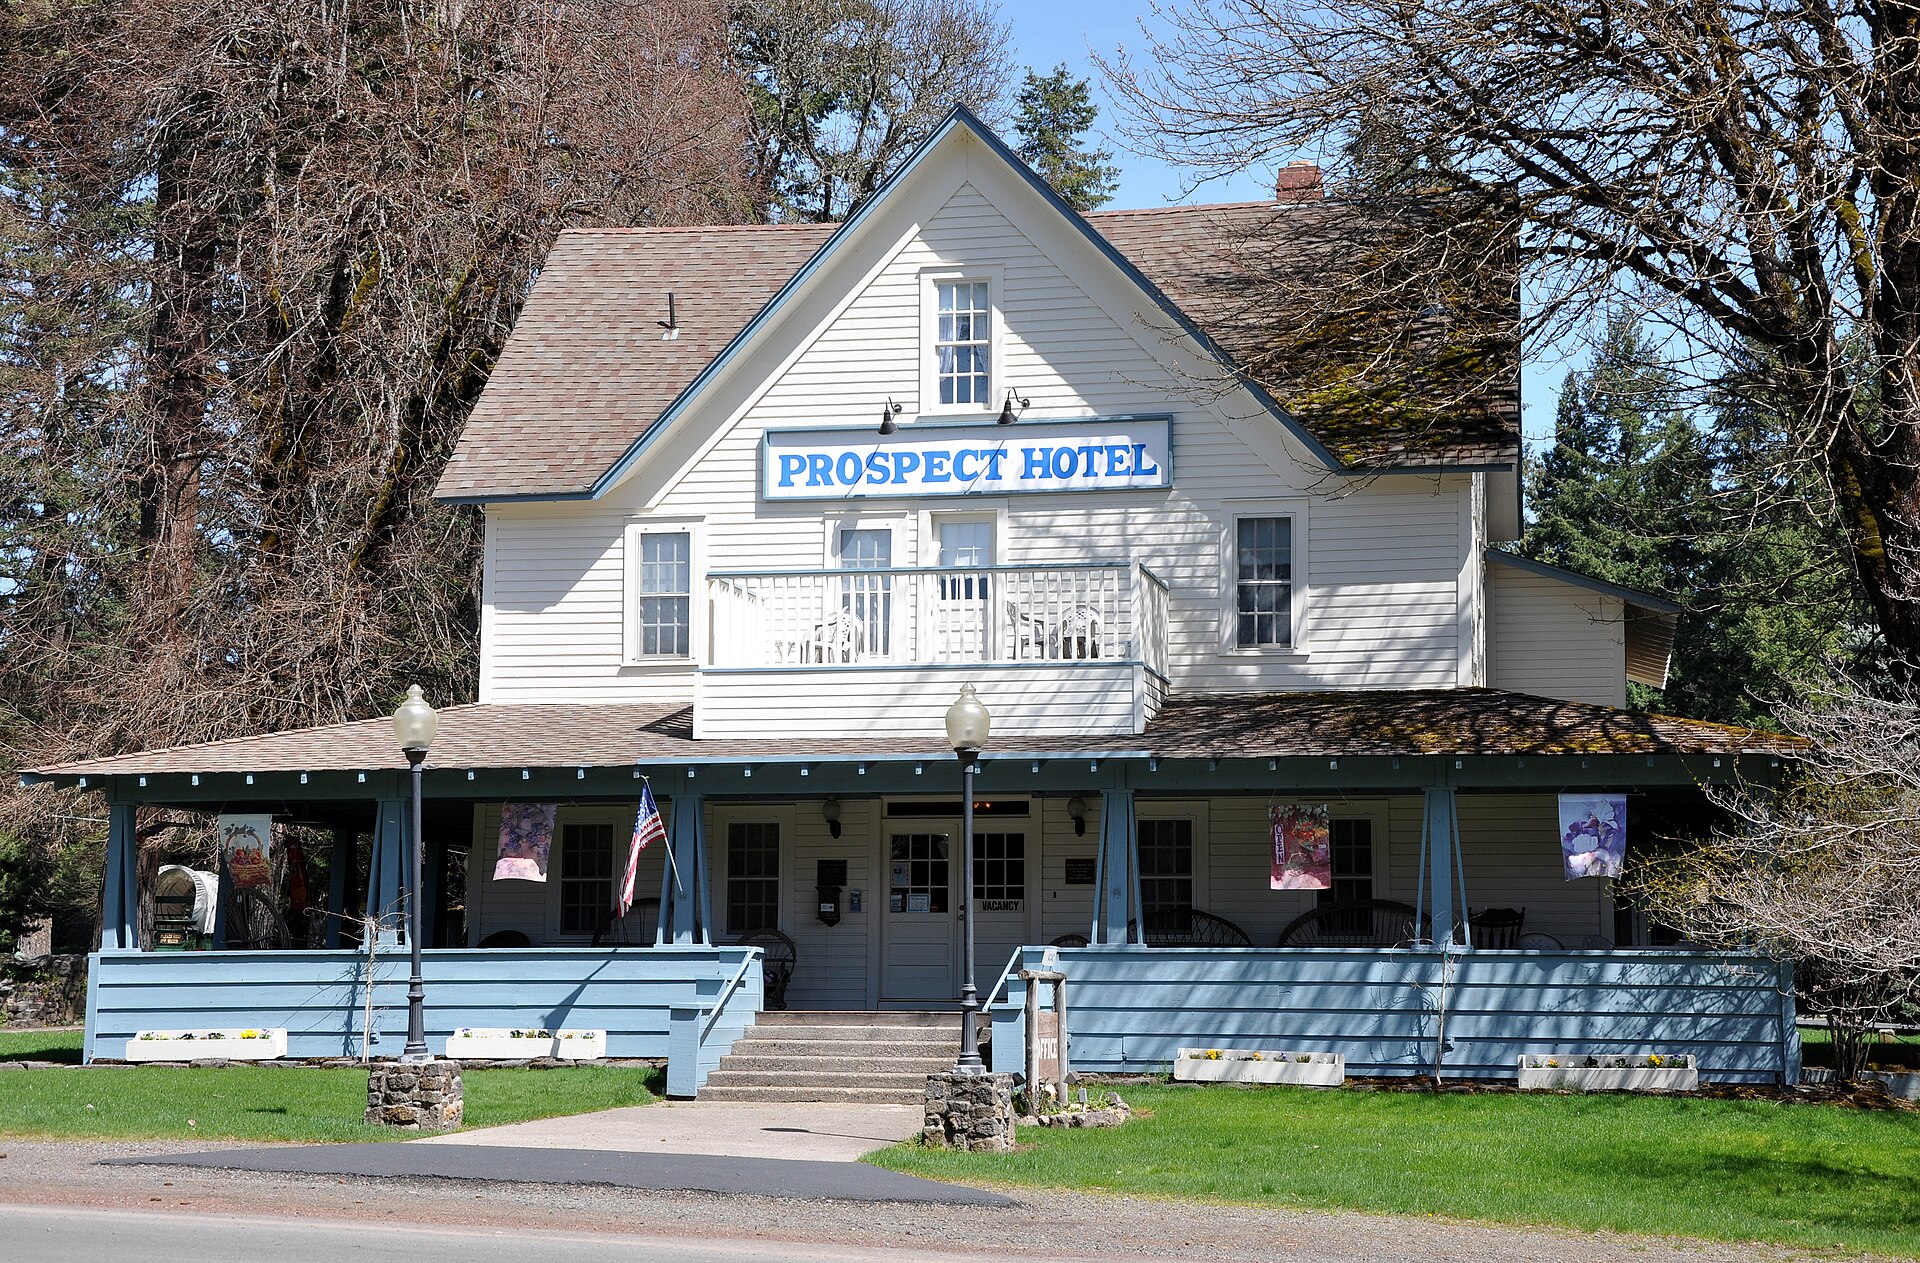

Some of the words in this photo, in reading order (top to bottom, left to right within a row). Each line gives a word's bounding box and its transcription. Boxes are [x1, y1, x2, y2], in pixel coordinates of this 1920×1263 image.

[778, 448, 1007, 488] PROSPECT
[1020, 443, 1158, 480] HOTEL
[1275, 824, 1284, 864] OPEN
[981, 900, 1019, 911] VACANCY
[1038, 1037, 1057, 1060] OFFICE
